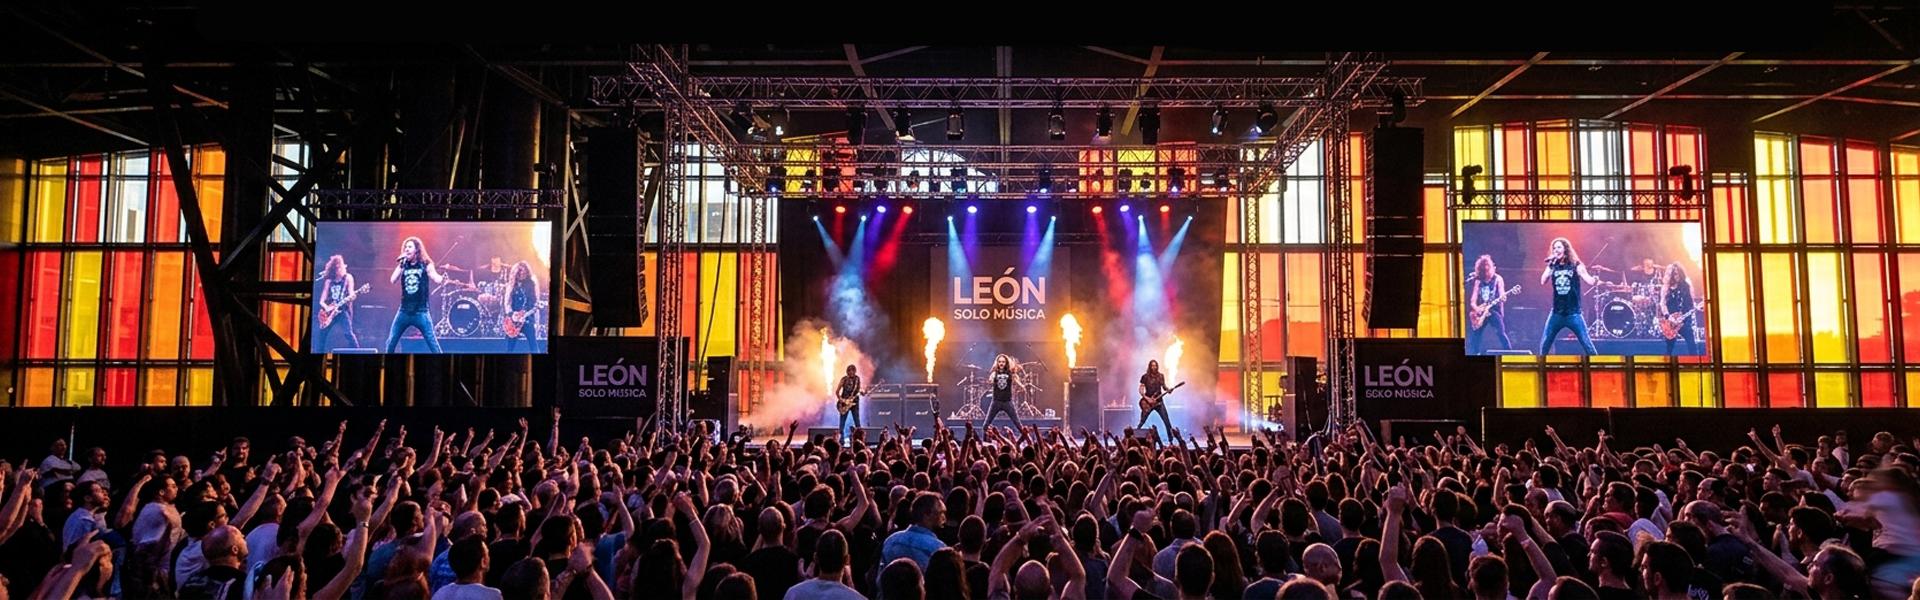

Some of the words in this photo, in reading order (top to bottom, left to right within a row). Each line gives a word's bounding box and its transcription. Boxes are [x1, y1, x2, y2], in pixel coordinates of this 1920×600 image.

[953, 267, 1046, 305] LEÓN
[953, 308, 990, 320] SOLO
[578, 357, 647, 386] LEÓN
[1364, 358, 1434, 387] LEÓN
[578, 388, 606, 397] SOLO
